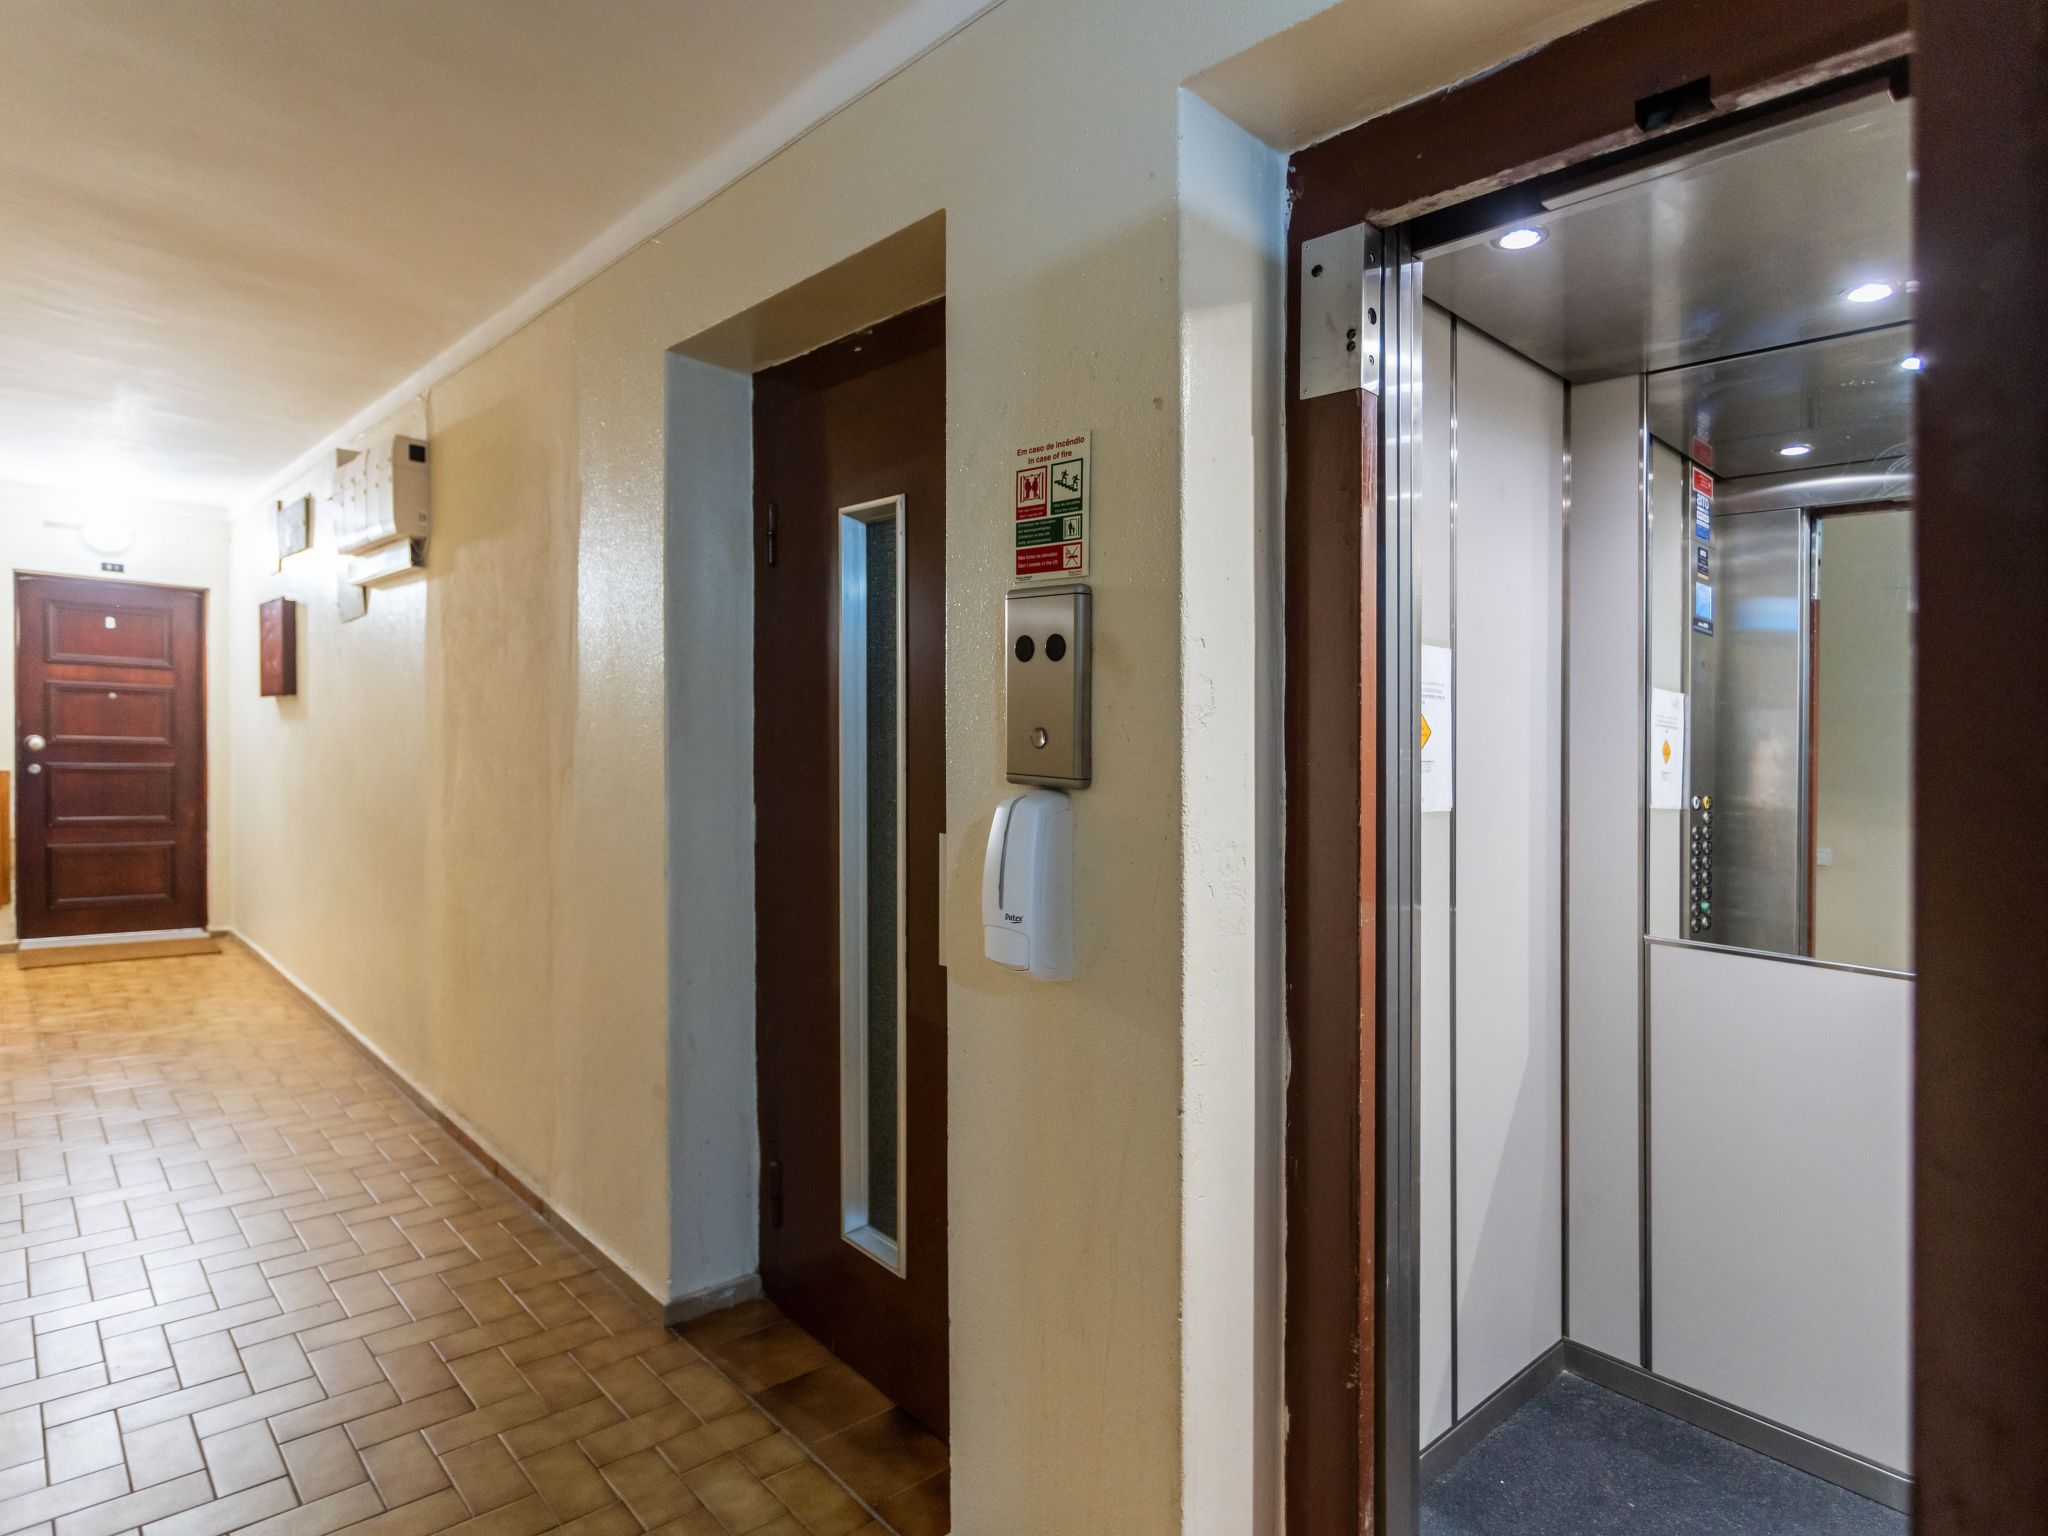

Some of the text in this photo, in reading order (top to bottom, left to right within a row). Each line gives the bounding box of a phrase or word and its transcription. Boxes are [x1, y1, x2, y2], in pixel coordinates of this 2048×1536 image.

[1029, 446, 1044, 454] caso
[1056, 436, 1085, 448] incêndio
[1036, 455, 1051, 463] case
[1053, 452, 1060, 460] of
[1061, 450, 1072, 458] fire
